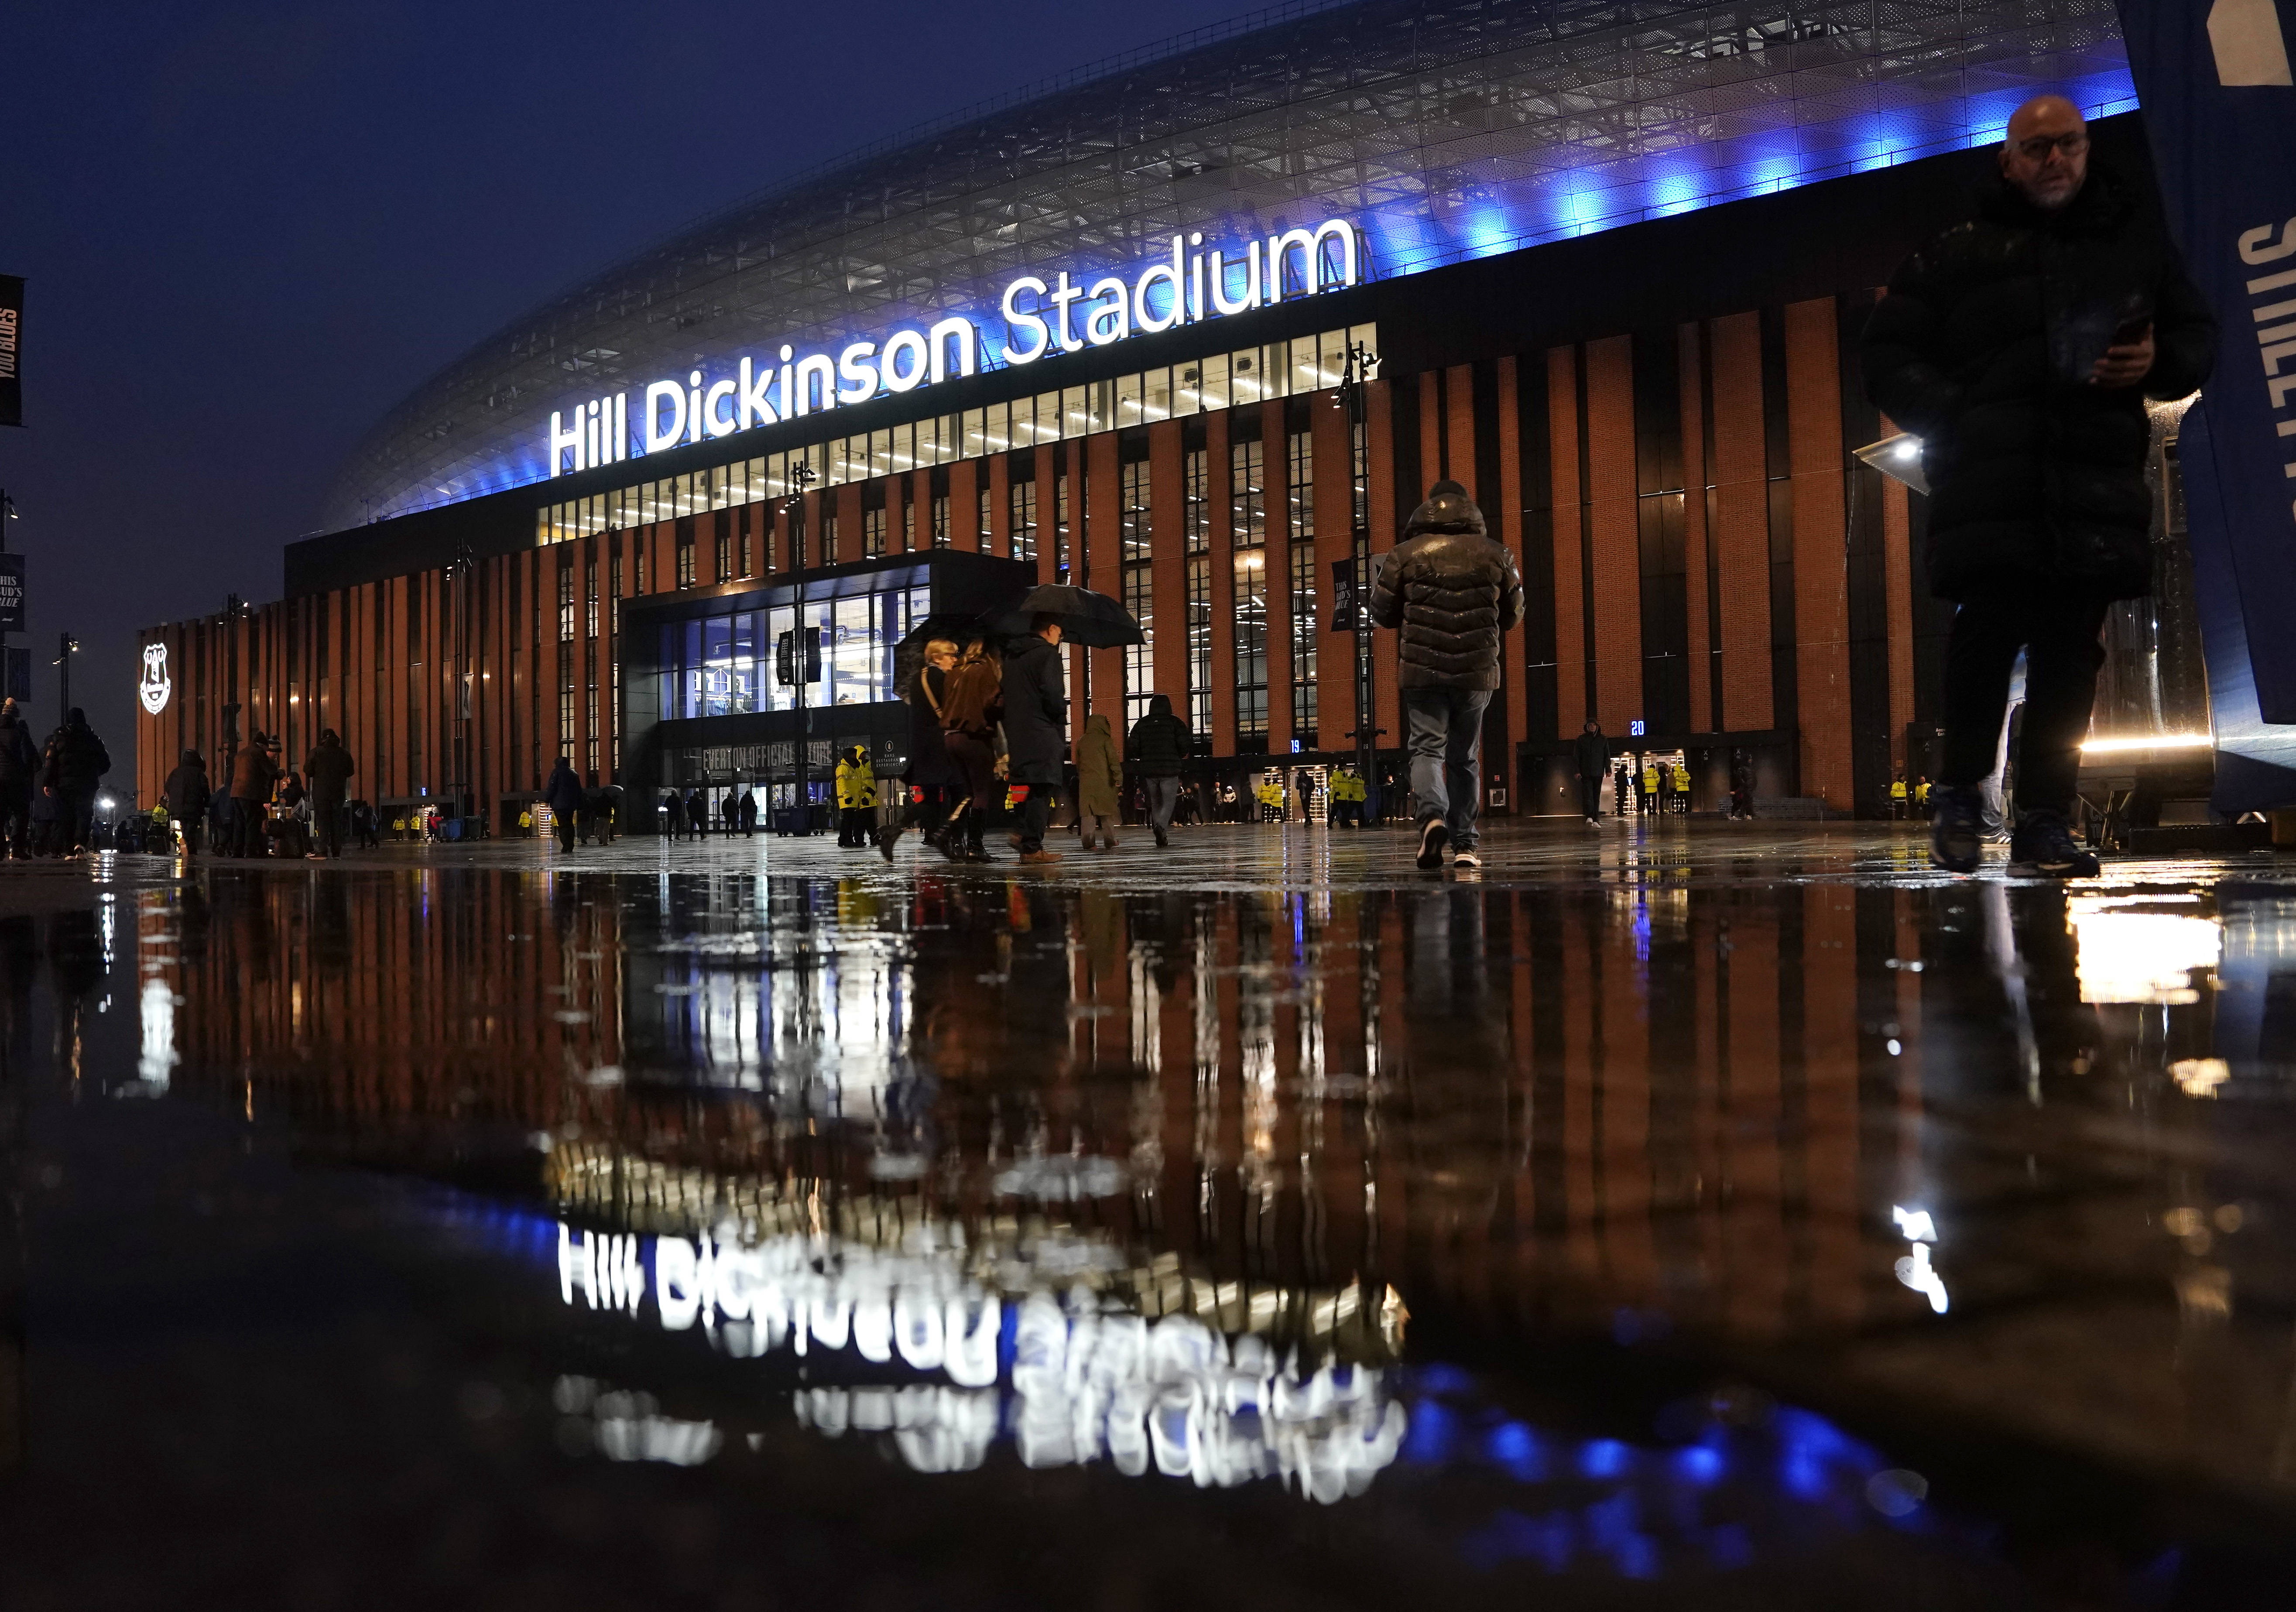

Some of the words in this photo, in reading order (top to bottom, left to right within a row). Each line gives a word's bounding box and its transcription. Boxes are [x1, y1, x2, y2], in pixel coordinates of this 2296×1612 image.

[0, 308, 17, 352] BLUES
[551, 393, 626, 477] Hill
[646, 317, 974, 453] Dickinson
[1001, 219, 1356, 364] Stadium
[0, 575, 17, 586] HIS
[1335, 581, 1347, 592] THIS
[0, 586, 22, 597] UD'S
[1631, 720, 1644, 736] 20
[1291, 739, 1299, 753] 19
[703, 747, 746, 770] EVERTON
[749, 743, 795, 768] OFFICIAL
[806, 741, 833, 765] TORE
